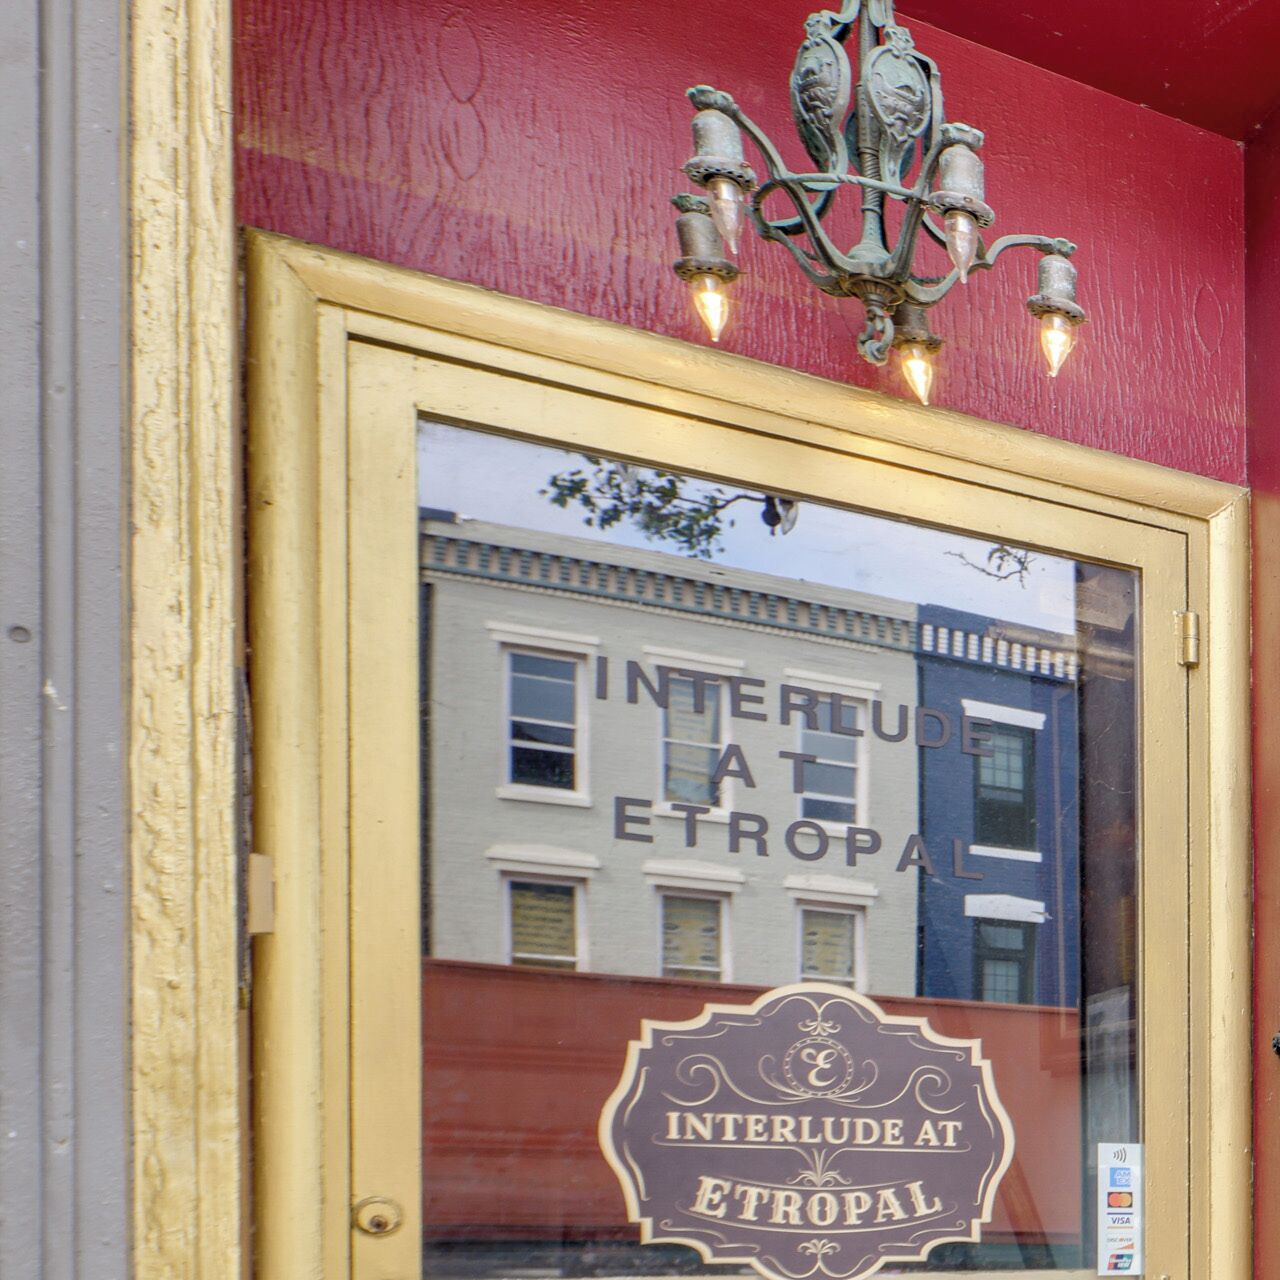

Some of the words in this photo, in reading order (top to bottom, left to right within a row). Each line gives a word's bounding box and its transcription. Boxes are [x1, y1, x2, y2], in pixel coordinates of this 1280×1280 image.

[596, 656, 994, 758] INTERLUDE
[614, 796, 985, 880] ETROPAL
[665, 1111, 904, 1145] INTERLUDE
[914, 1119, 963, 1147] AT
[688, 1175, 943, 1227] ETROPAL
[1111, 1216, 1131, 1225] VISA
